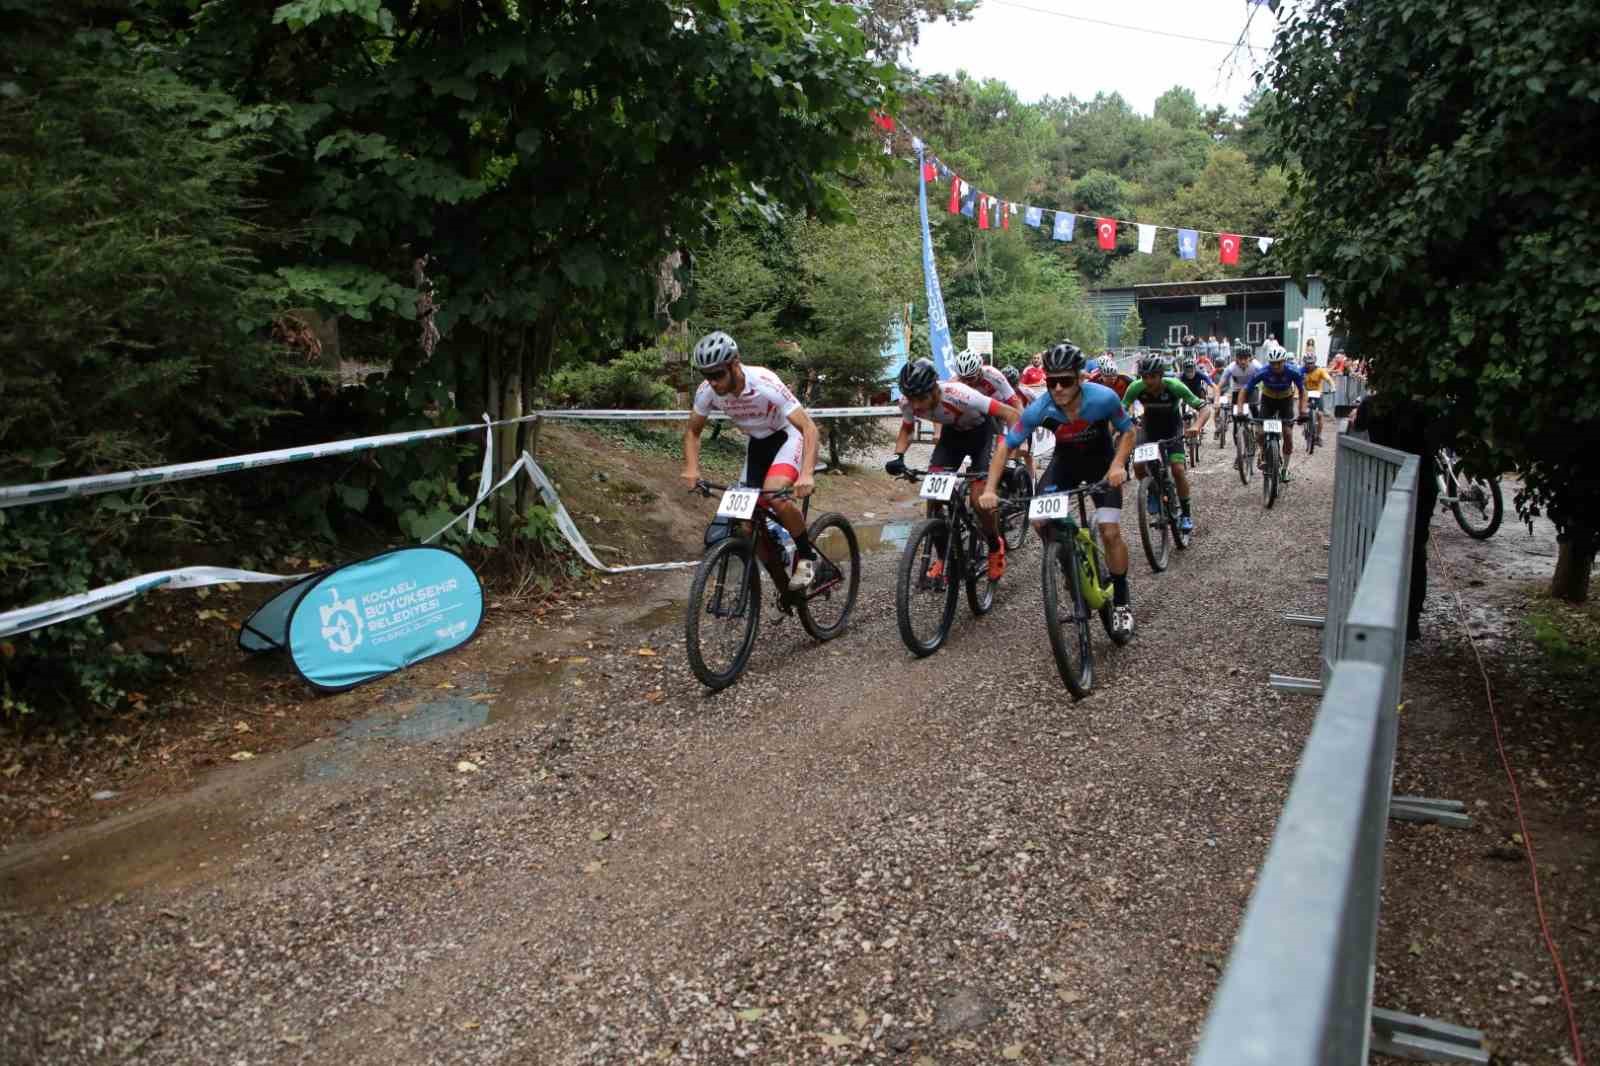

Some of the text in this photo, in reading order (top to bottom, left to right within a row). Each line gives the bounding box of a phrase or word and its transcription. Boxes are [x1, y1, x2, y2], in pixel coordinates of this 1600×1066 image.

[927, 475, 948, 494] 301
[725, 493, 751, 512] 303
[1036, 498, 1061, 515] 300
